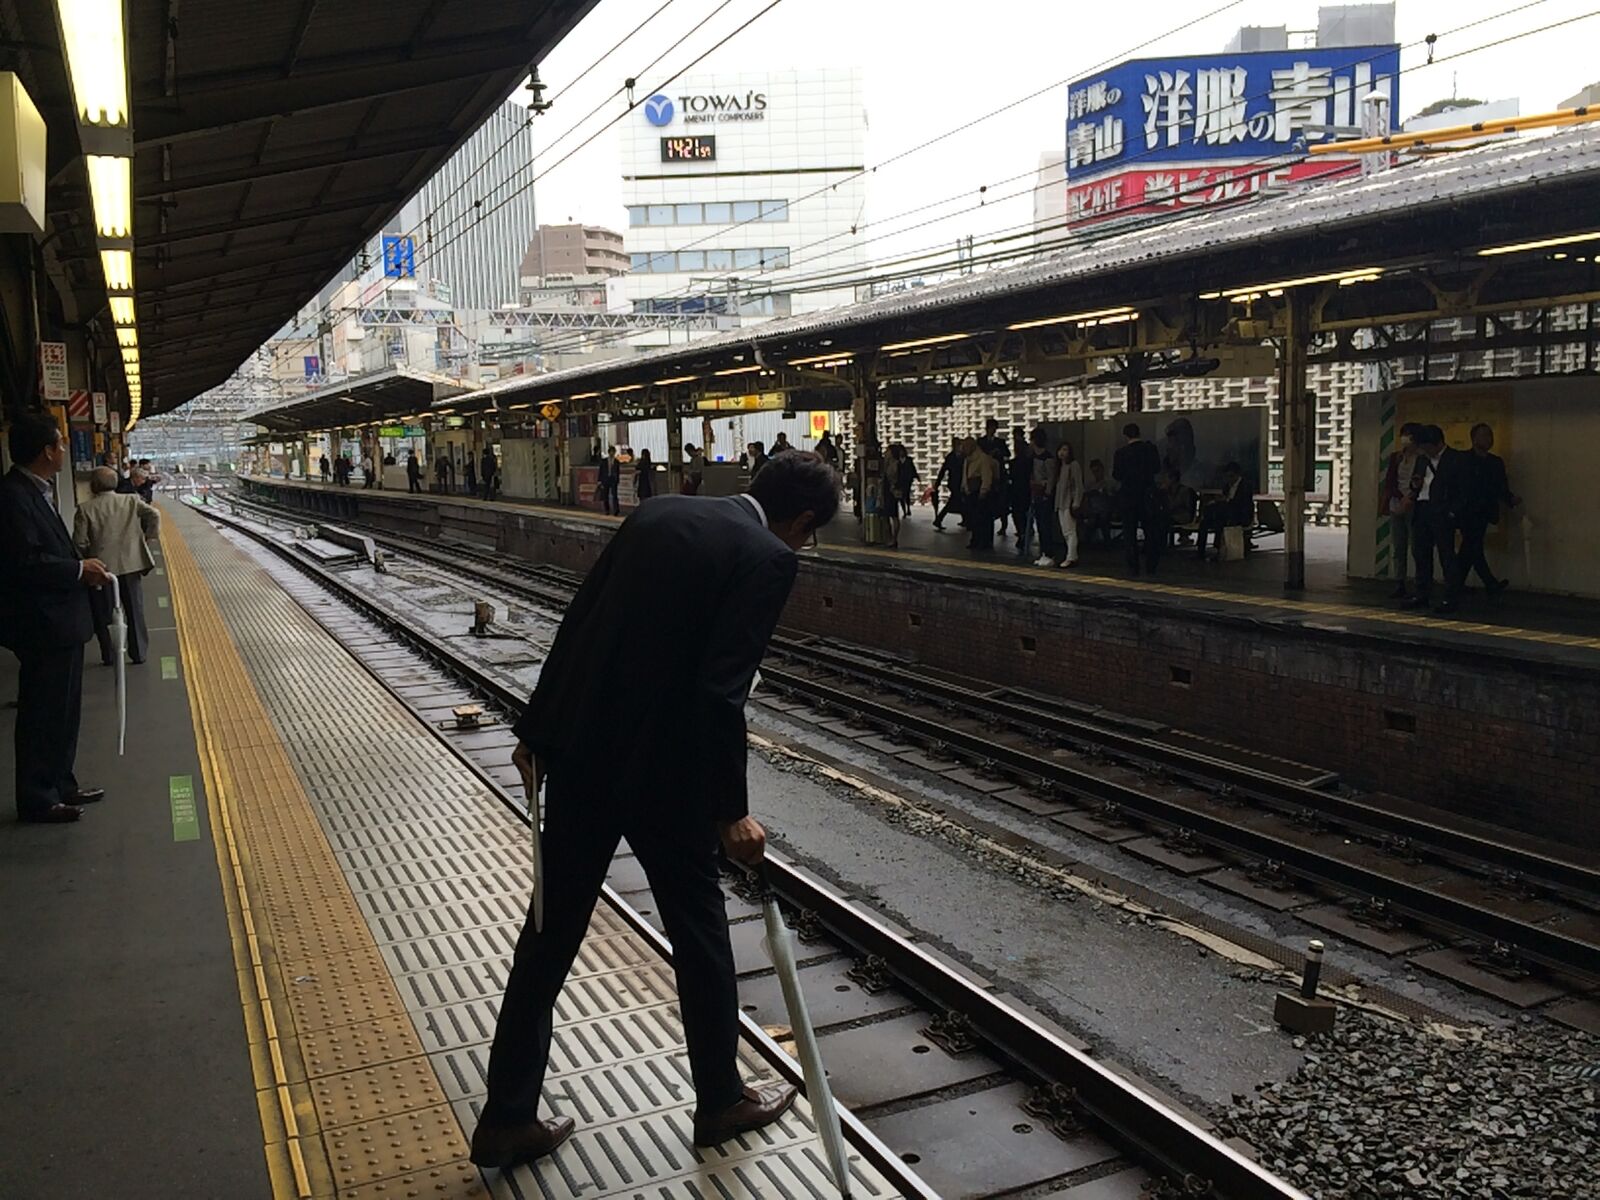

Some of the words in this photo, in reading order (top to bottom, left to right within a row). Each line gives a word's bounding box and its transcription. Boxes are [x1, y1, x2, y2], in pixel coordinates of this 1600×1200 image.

[684, 114, 715, 124] AMENITY
[718, 112, 764, 122] COMPOSERS
[1070, 80, 1122, 120] 洋服の
[1141, 61, 1391, 149] 洋服の青山
[1068, 115, 1123, 169] 青山
